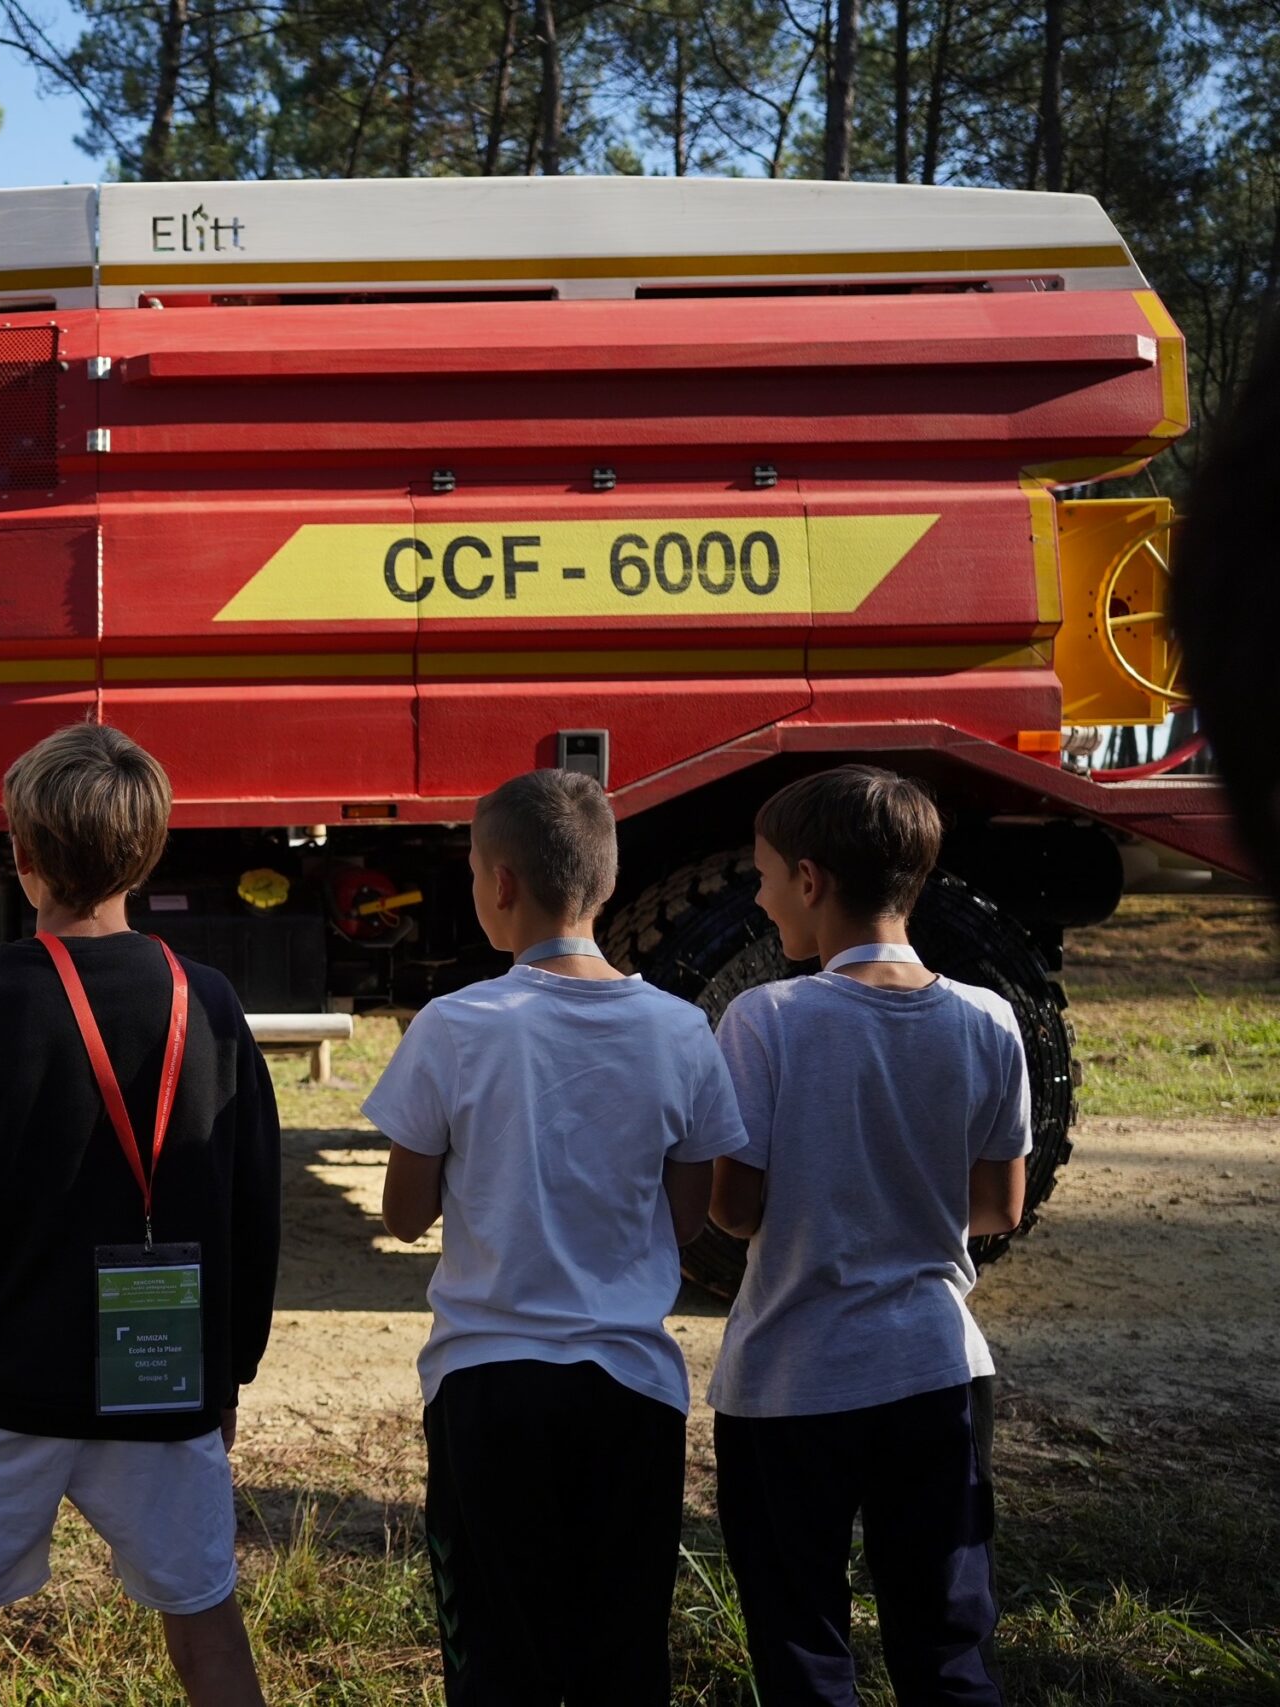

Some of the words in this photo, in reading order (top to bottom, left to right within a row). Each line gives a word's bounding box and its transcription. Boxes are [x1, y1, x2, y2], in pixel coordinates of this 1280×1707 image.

[152, 204, 245, 252] Elitt
[383, 535, 541, 602] CCF
[562, 566, 586, 580] -
[609, 530, 780, 596] 6000
[135, 1360, 167, 1368] CM1-CM2
